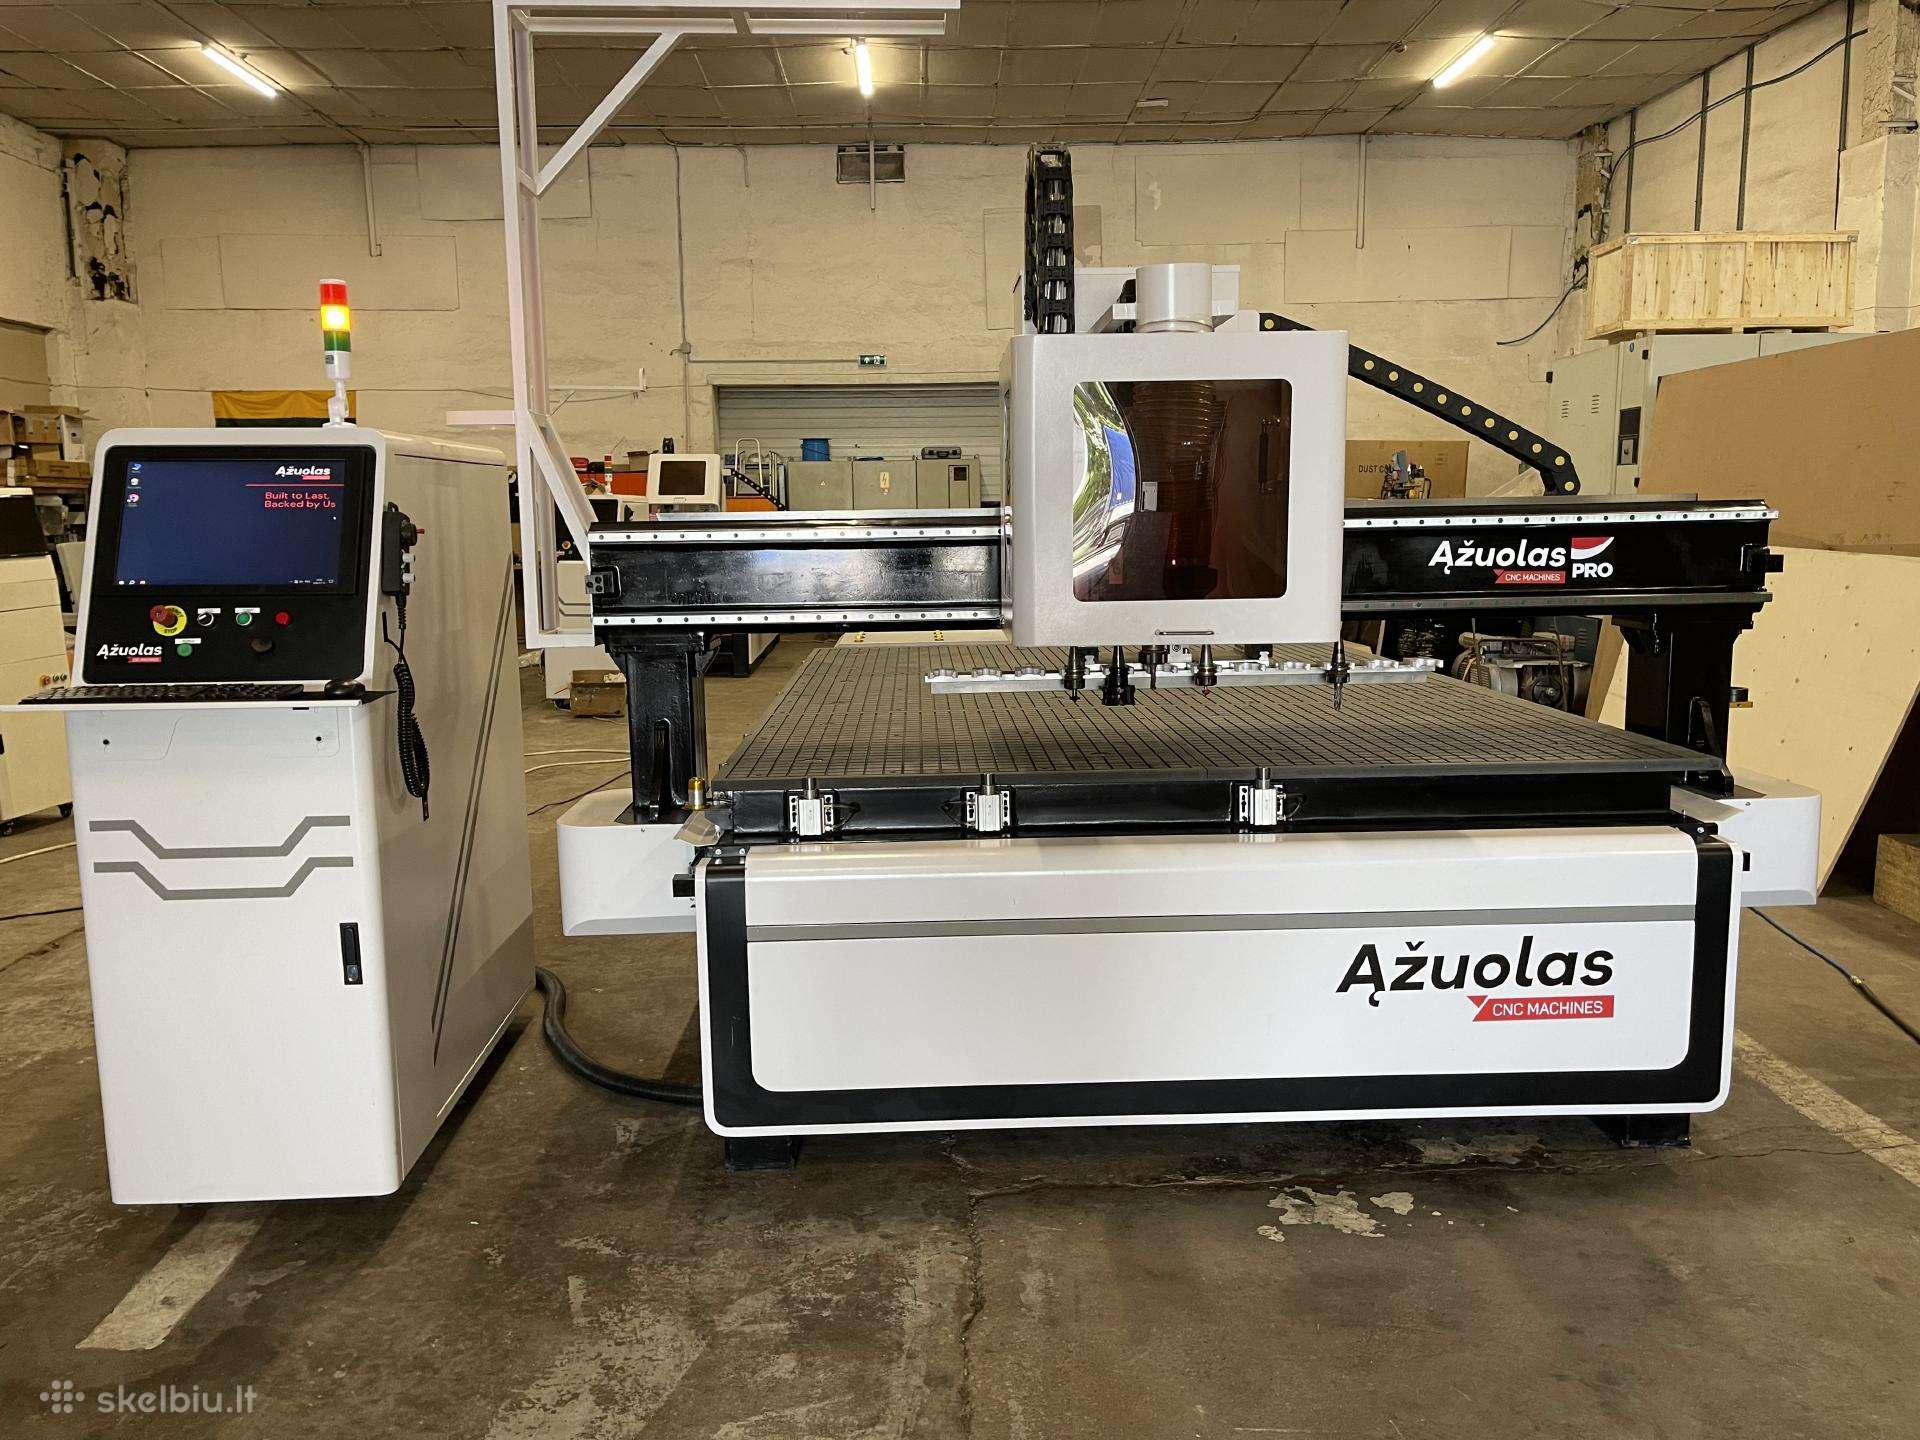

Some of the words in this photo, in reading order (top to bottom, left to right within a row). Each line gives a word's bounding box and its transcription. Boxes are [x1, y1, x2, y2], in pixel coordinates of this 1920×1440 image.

[275, 465, 331, 477] Ažuolas
[1358, 464, 1378, 473] DUST
[265, 492, 288, 500] Built
[291, 492, 303, 500] to
[306, 500, 320, 509] by
[1428, 538, 1567, 575] Ažuolas
[1504, 573, 1522, 582] CNC
[1523, 573, 1561, 582] MACHINES
[1571, 562, 1614, 579] PRO
[96, 643, 163, 660] Ažuolas
[1335, 935, 1614, 1008] Ažuolas
[1492, 1003, 1523, 1017] CNC
[1527, 1000, 1604, 1015] MACHINES
